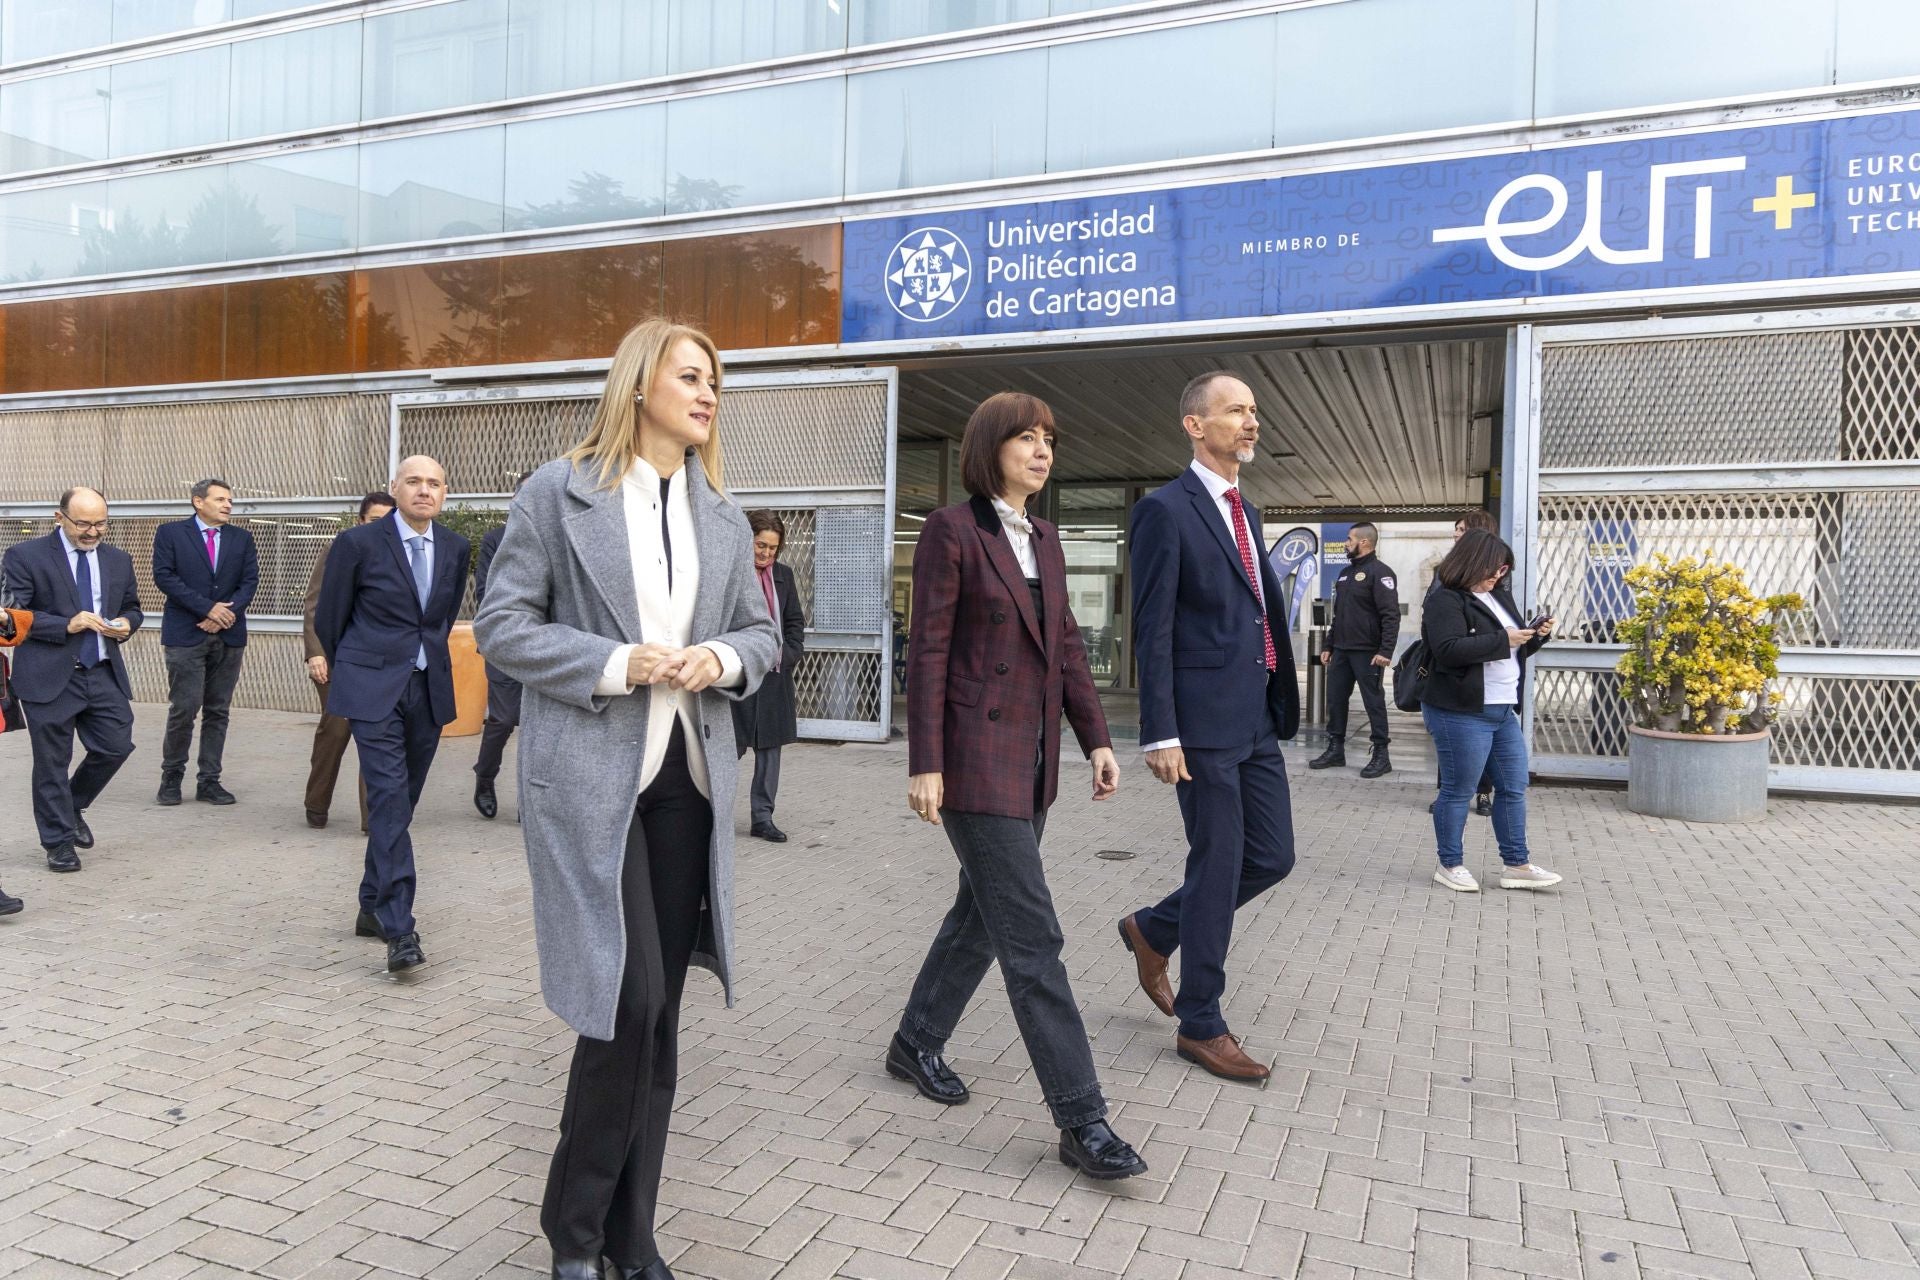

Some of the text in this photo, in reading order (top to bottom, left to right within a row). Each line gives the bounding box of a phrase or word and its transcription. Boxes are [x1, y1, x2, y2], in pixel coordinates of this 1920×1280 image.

[988, 205, 1155, 248] Universidad
[1847, 210, 1920, 234] TECH
[1242, 233, 1360, 255] MIEMBRO DE
[987, 248, 1137, 283] Politécnica
[986, 284, 1176, 319] de Cartagena
